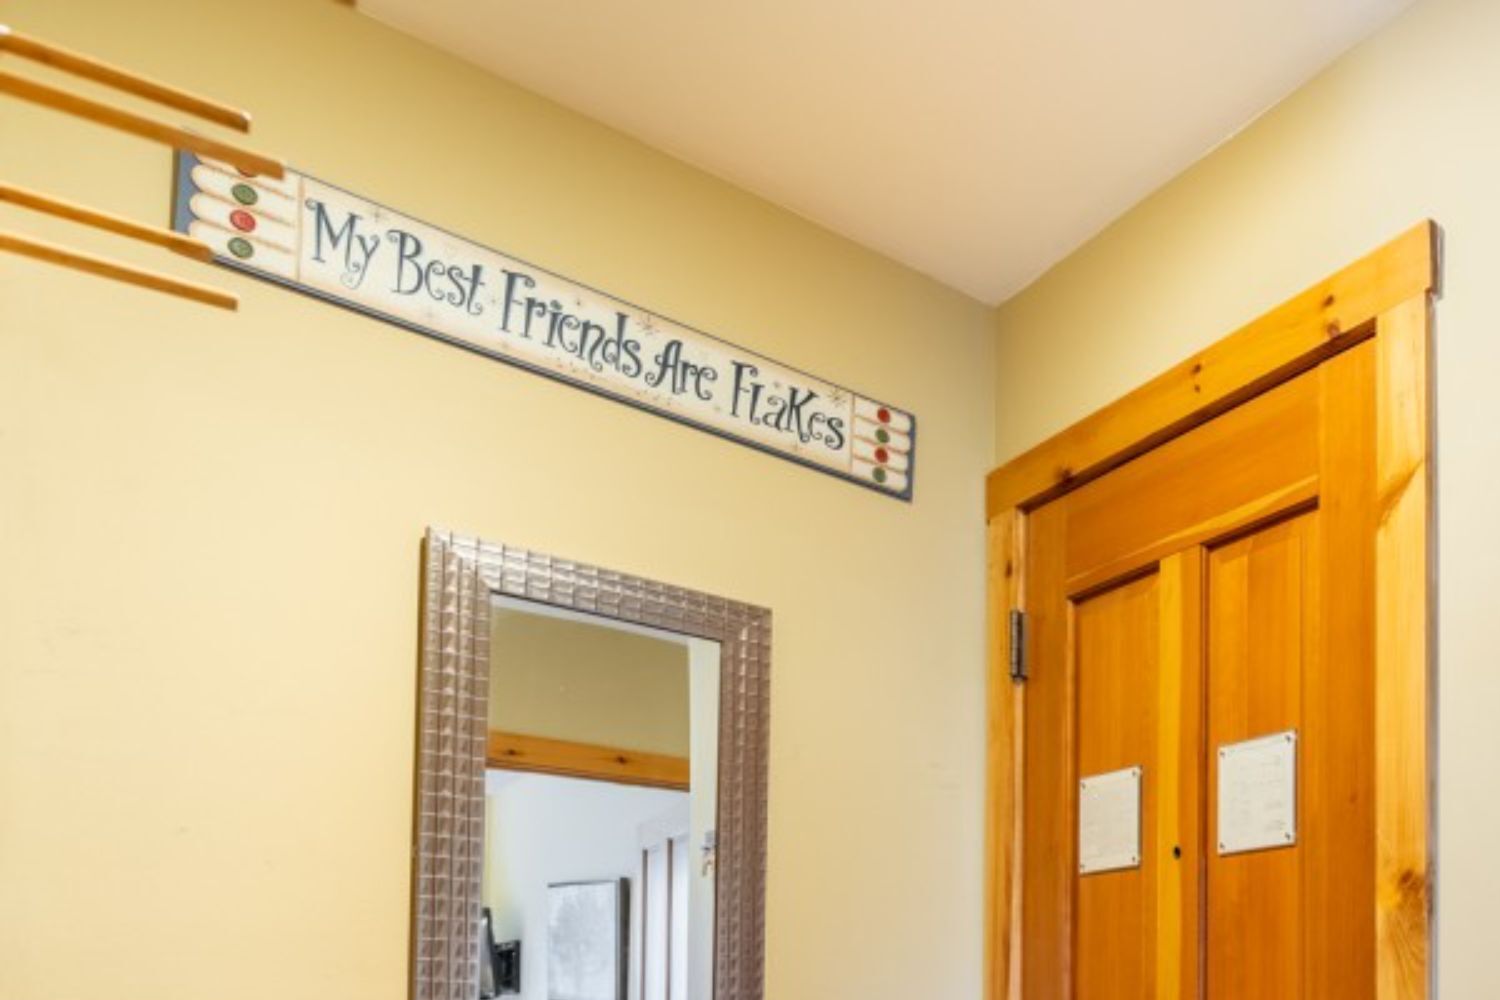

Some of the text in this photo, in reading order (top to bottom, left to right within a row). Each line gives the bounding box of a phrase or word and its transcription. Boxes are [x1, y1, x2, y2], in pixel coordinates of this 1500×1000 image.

[305, 198, 380, 290] My
[387, 228, 486, 316] Best
[500, 269, 643, 379] Friends
[644, 339, 718, 401] Are
